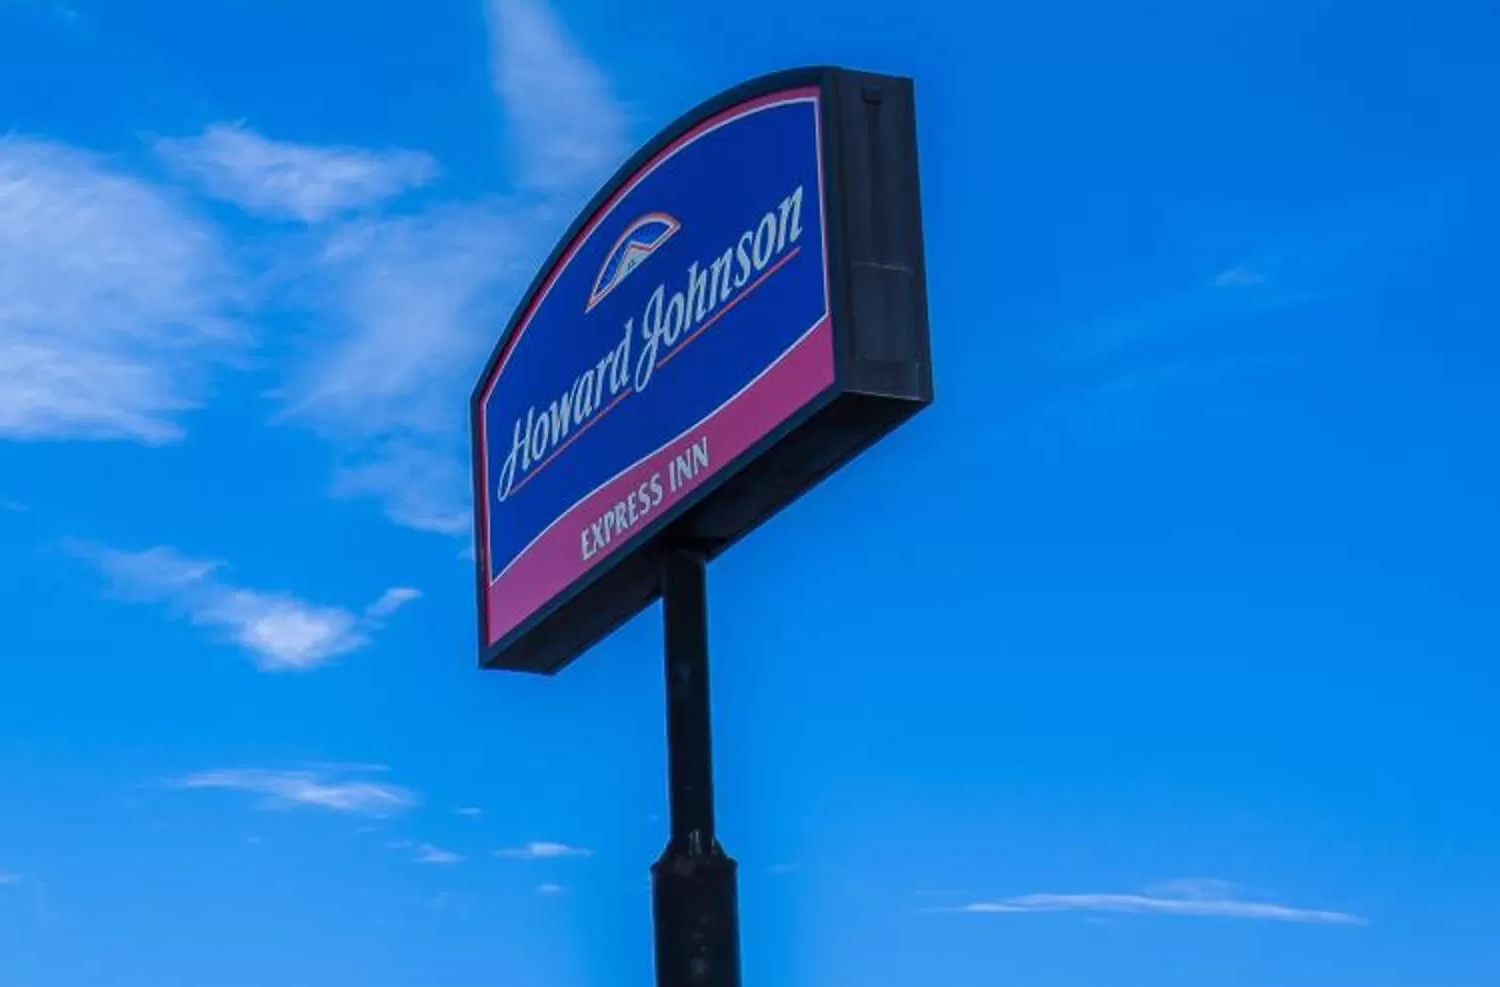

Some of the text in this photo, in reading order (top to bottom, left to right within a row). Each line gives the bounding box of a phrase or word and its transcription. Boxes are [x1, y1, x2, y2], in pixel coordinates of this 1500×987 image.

[498, 185, 803, 502] Howard Johnson
[580, 436, 709, 561] EXPRESS INN
